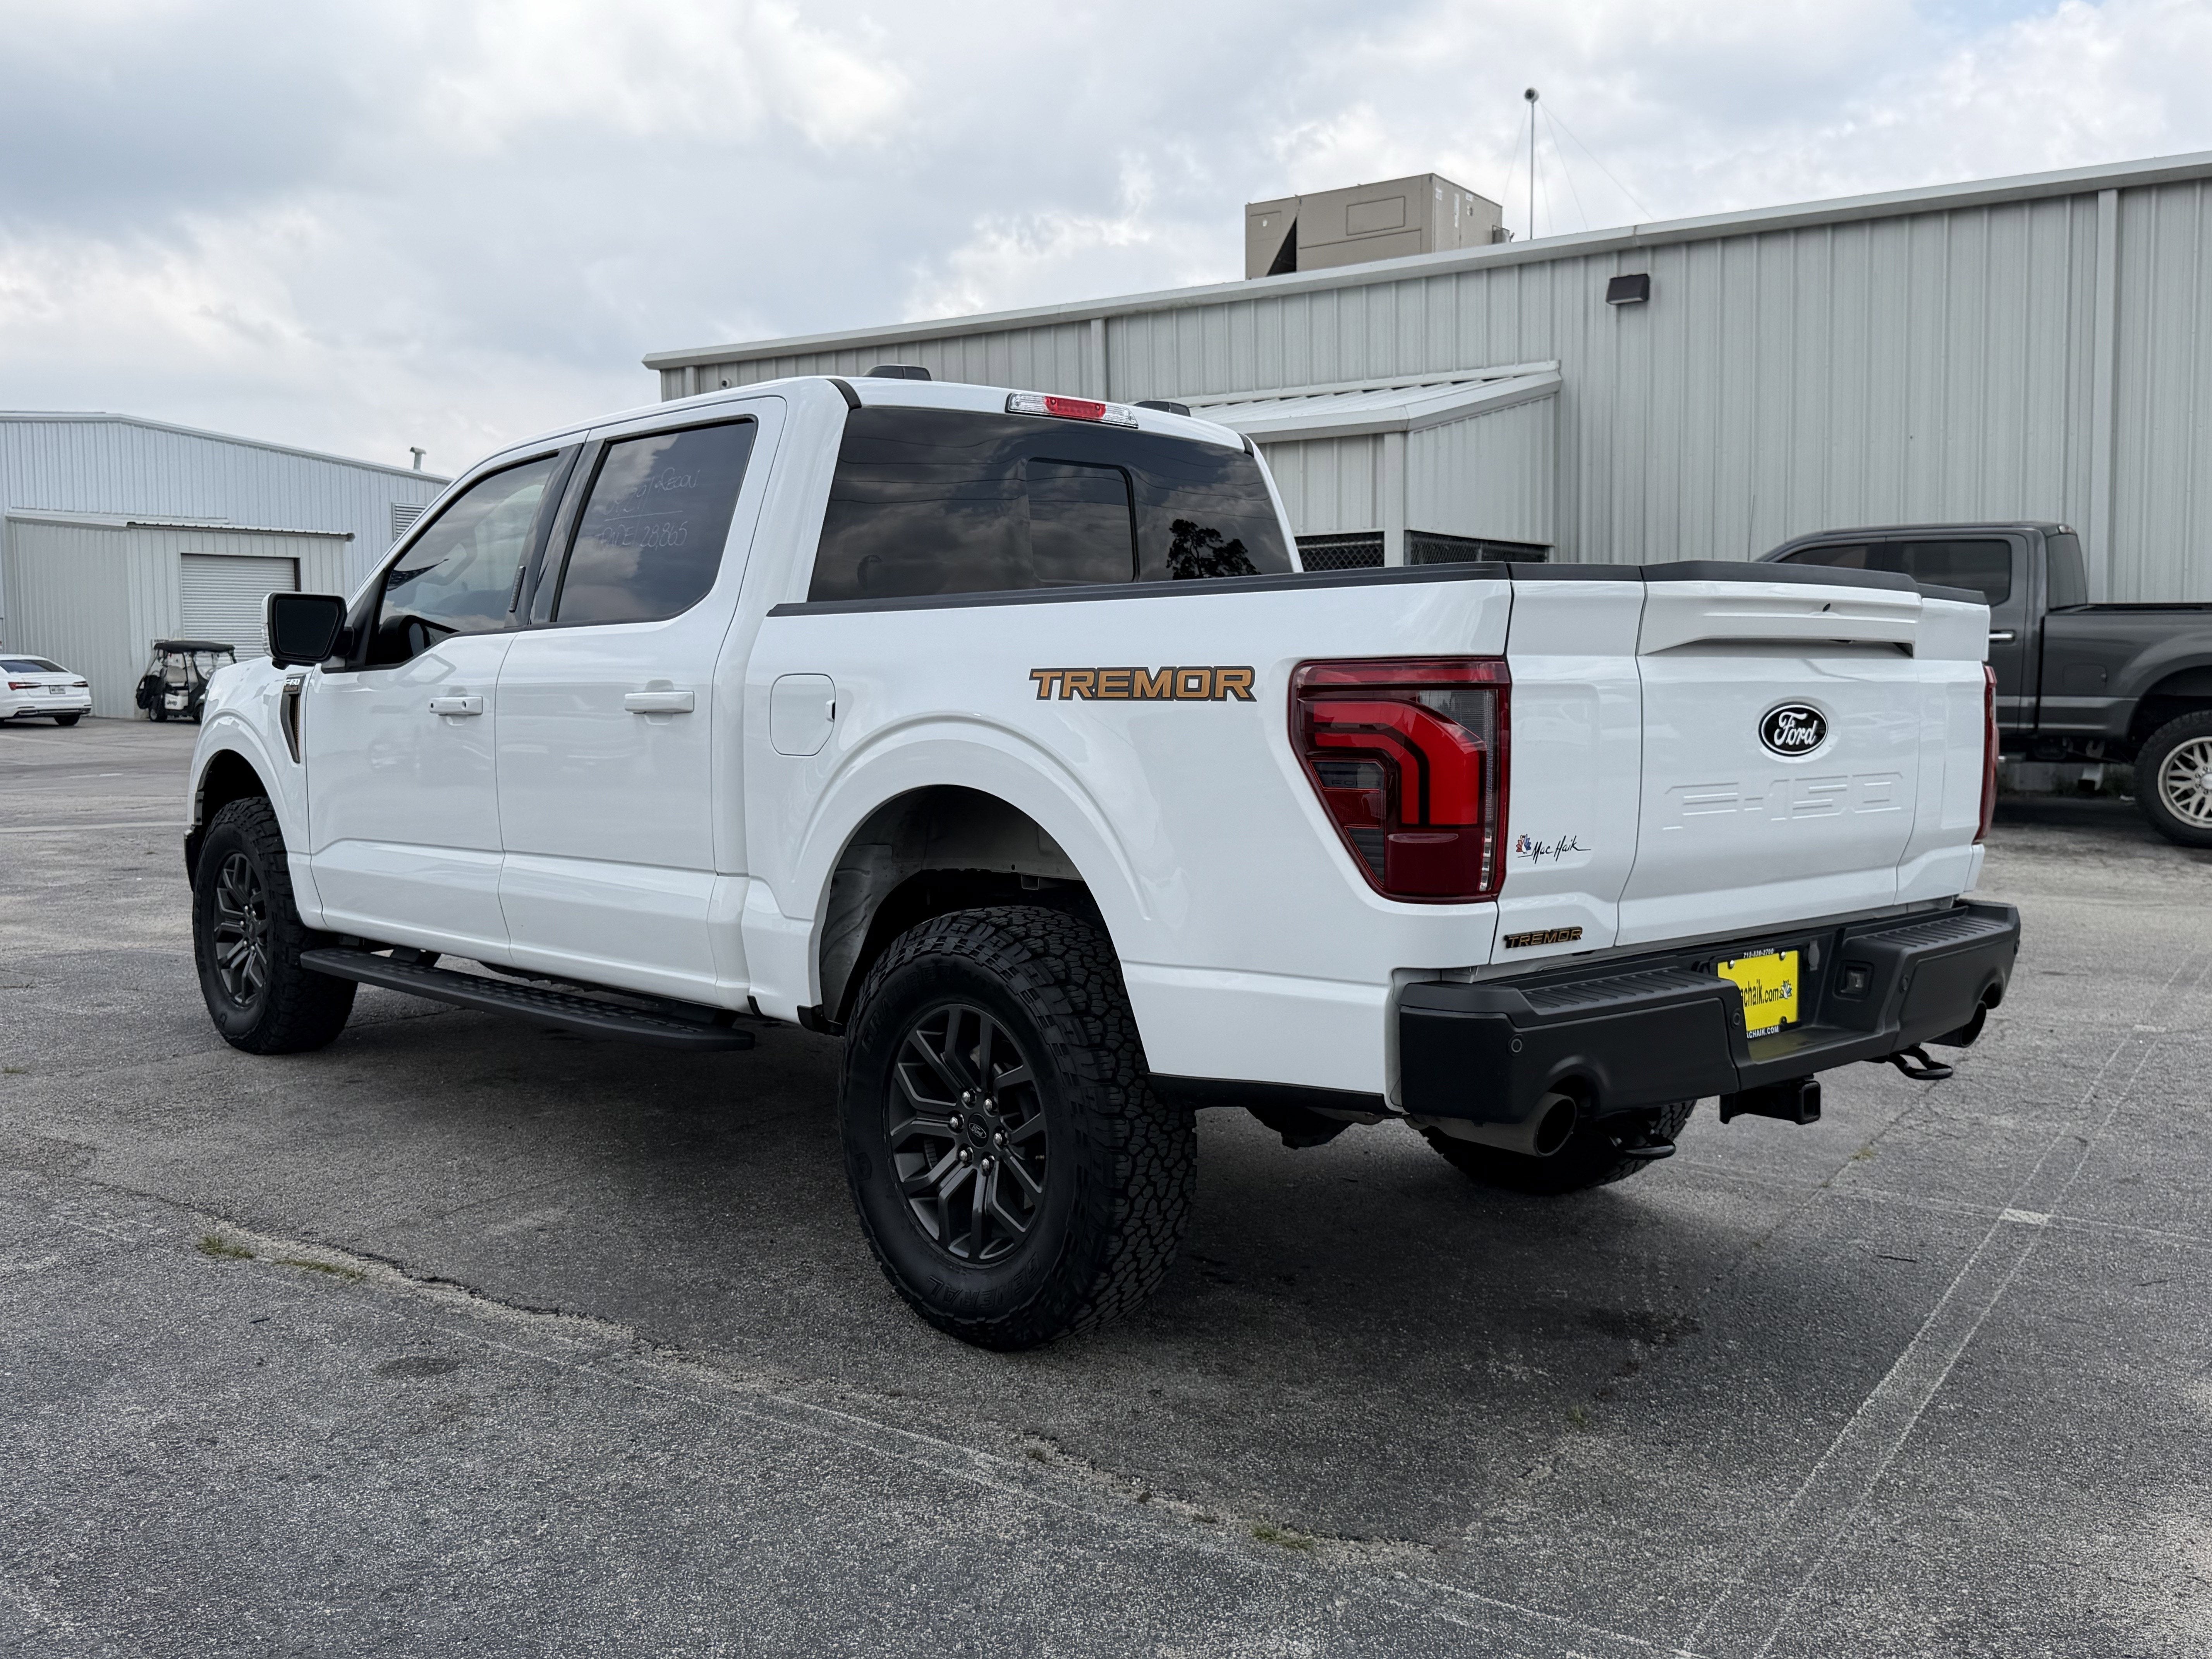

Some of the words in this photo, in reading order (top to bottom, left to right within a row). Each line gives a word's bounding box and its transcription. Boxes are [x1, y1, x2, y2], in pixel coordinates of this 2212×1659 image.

[1029, 665, 1257, 702] TREMOR
[1774, 711, 1818, 746] Ford
[1663, 772, 1903, 830] F-150
[1517, 841, 1554, 864] Mac
[1553, 835, 1591, 862] Haik
[1504, 926, 1583, 948] TREMOR
